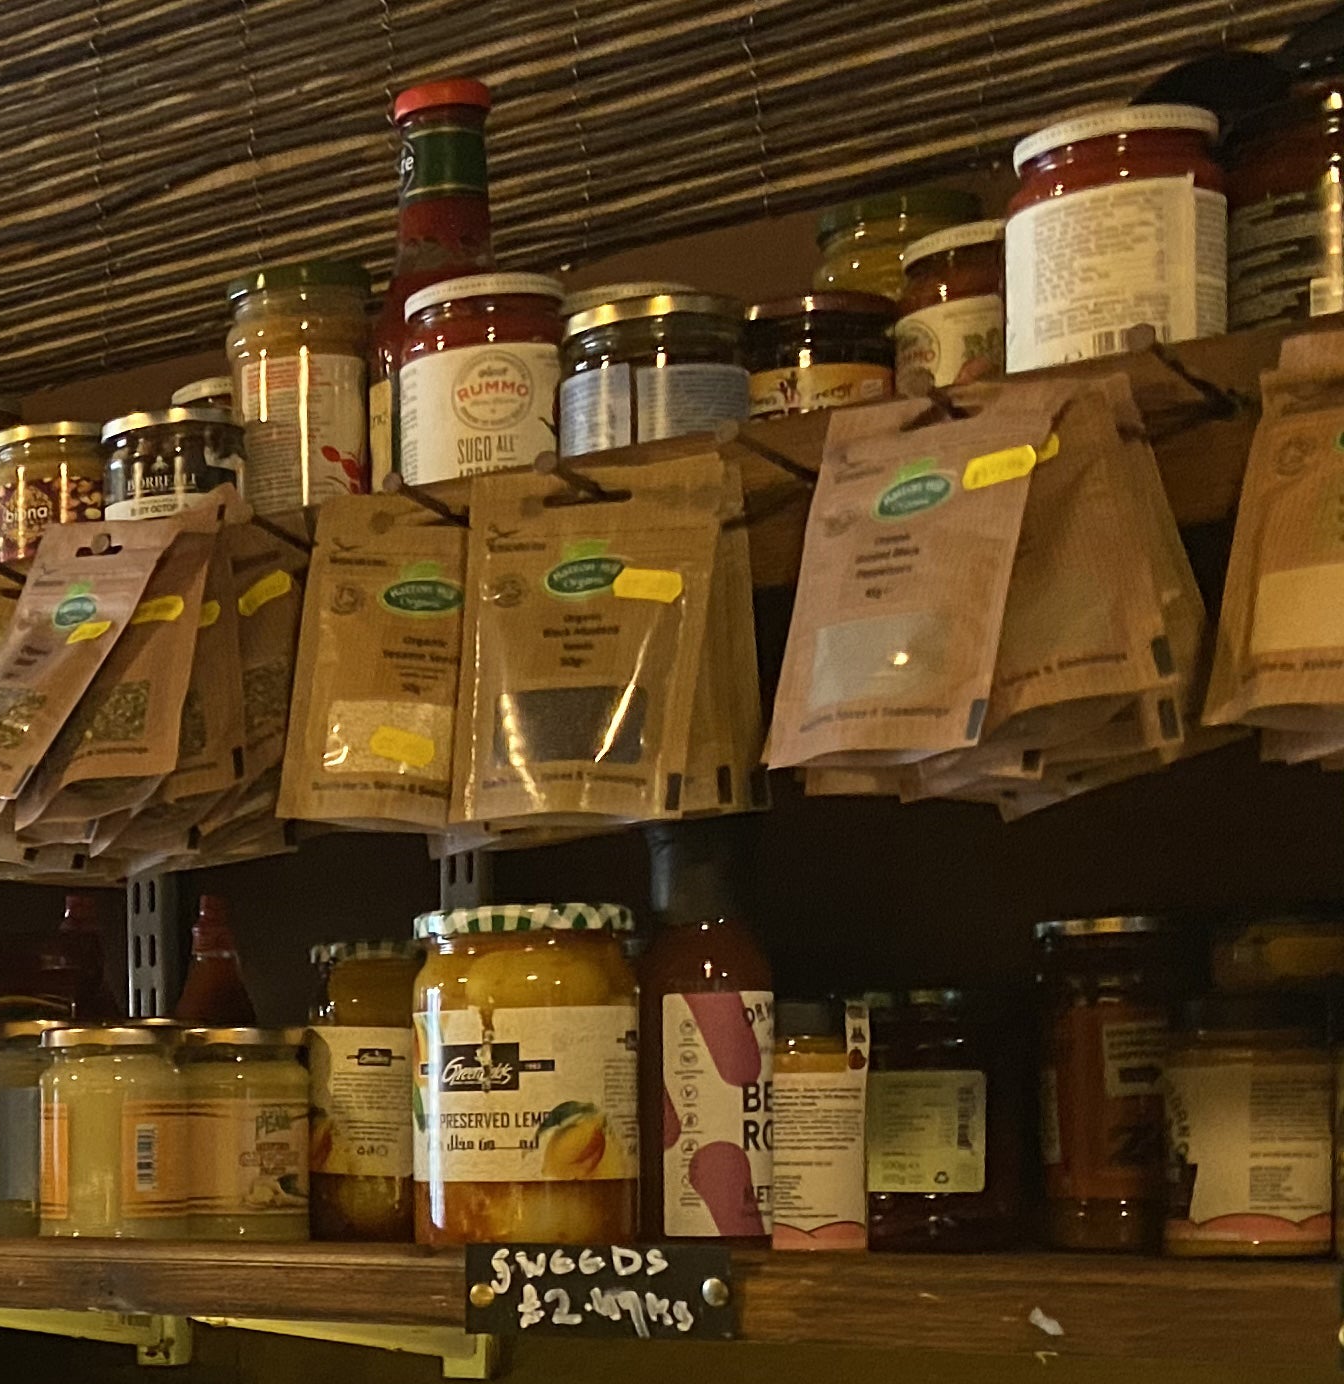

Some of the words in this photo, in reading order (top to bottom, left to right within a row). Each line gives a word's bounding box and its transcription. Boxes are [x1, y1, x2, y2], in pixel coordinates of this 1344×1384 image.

[457, 380, 529, 403] RUMMO
[457, 437, 492, 465] SUGO
[440, 1112, 510, 1129] PRESERVED
